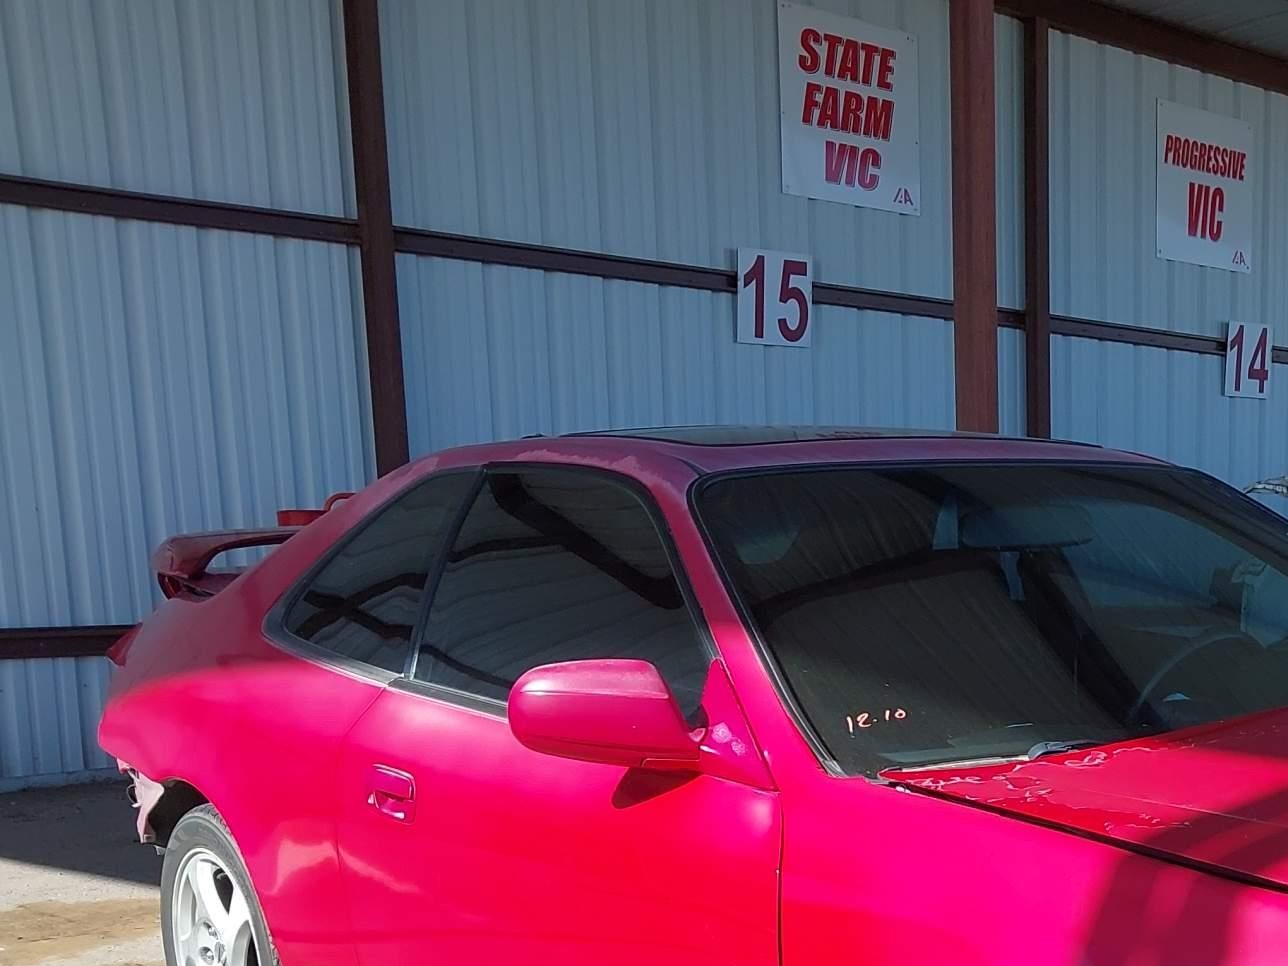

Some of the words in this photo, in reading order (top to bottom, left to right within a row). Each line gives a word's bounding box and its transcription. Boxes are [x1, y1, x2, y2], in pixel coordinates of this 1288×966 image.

[798, 28, 897, 92] STATE
[801, 81, 895, 142] FARM
[823, 140, 881, 192] VIC
[1163, 134, 1247, 181] PROGRESSIVE
[1187, 181, 1225, 242] VIC
[743, 254, 809, 343] 15
[1229, 324, 1269, 394] 14
